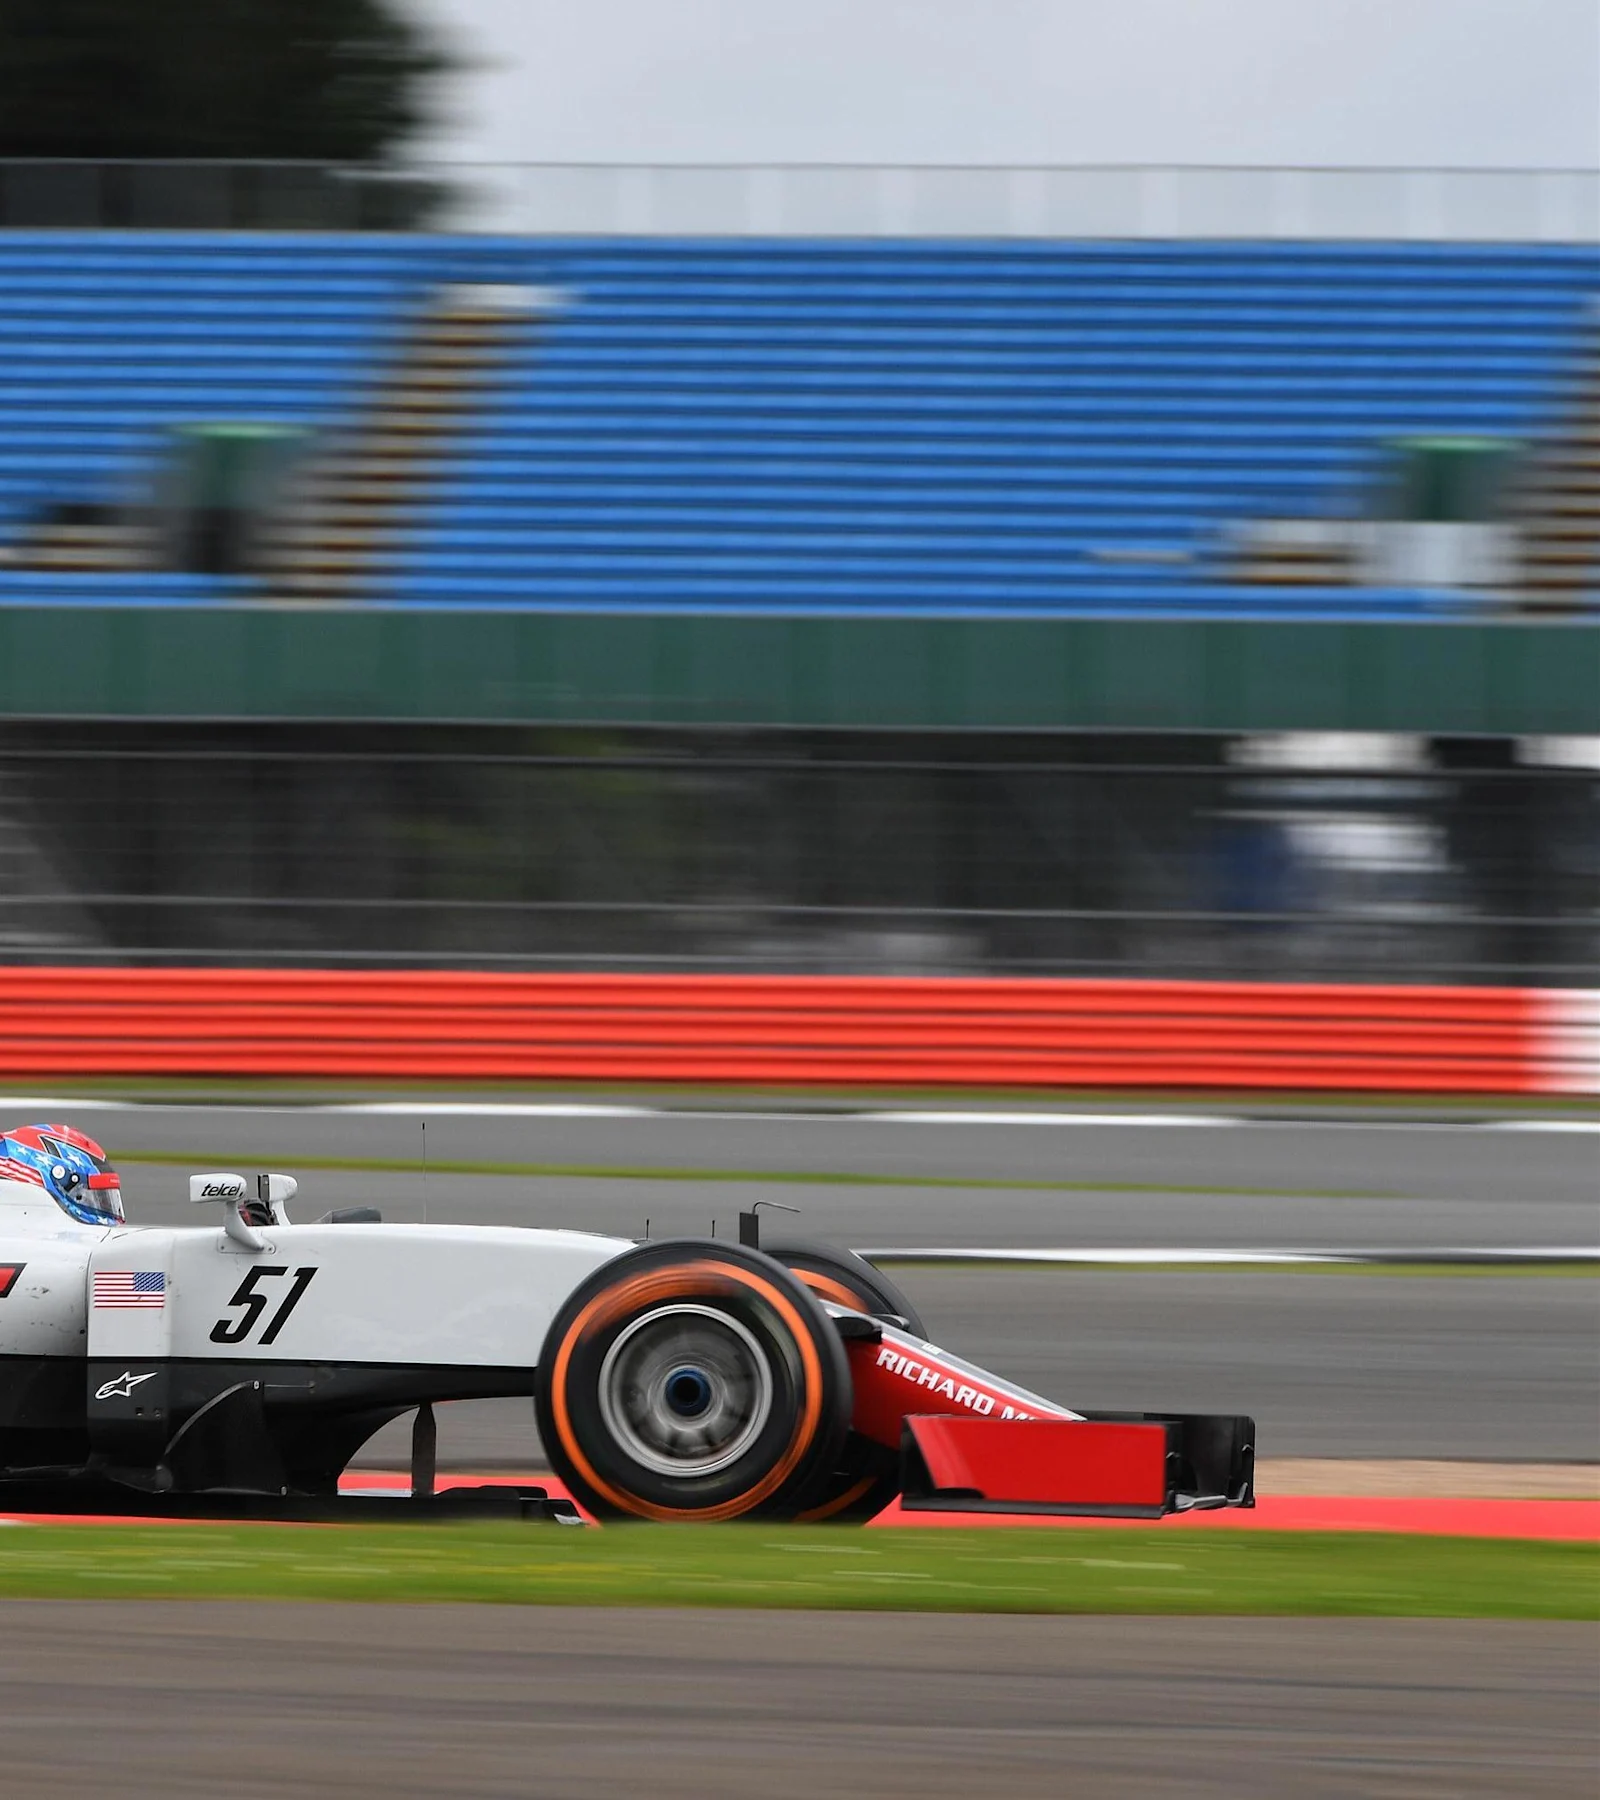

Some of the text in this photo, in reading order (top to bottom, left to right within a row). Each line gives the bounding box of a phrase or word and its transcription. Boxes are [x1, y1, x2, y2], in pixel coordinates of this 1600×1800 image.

[200, 1182, 242, 1198] telcel
[209, 1265, 319, 1345] 51
[875, 1348, 997, 1416] RICHARD
